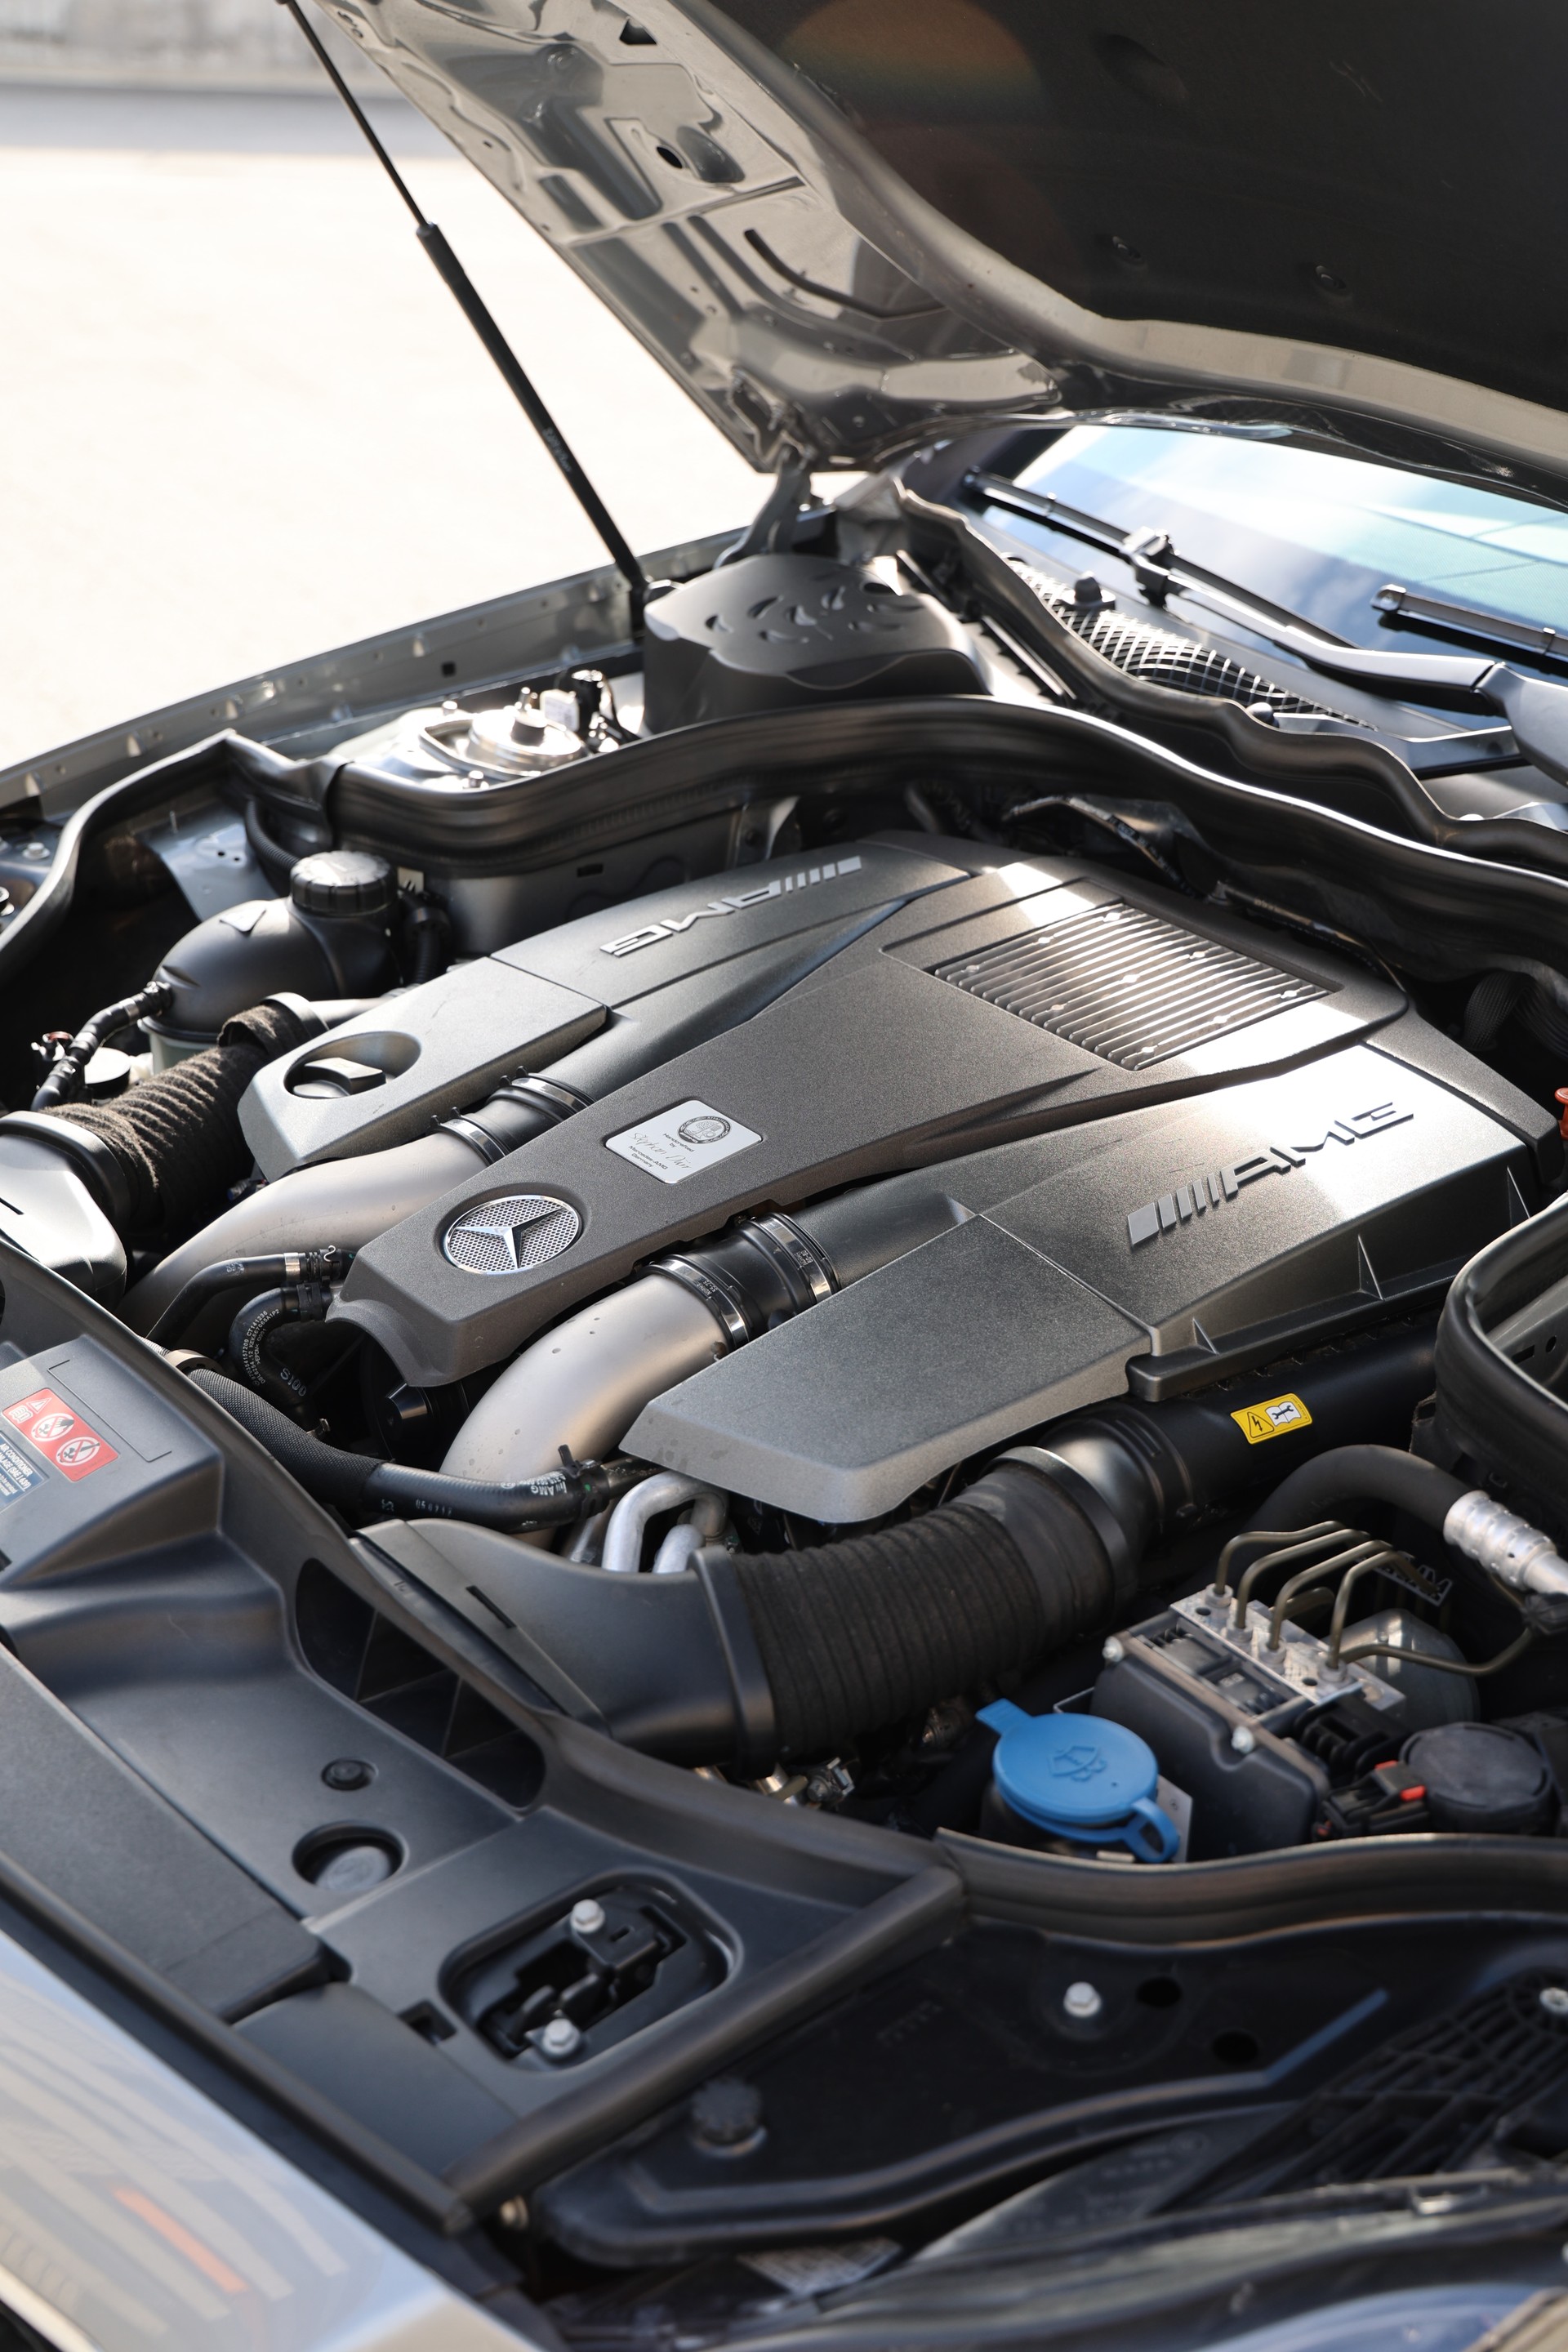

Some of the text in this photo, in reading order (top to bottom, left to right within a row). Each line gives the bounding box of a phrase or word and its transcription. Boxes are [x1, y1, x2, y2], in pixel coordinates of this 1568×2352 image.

[599, 879, 782, 958] AMG
[663, 1133, 696, 1153] Handcrafted
[1220, 1101, 1414, 1200] AMG
[628, 1145, 668, 1170] Mercedes-AMG
[631, 1153, 654, 1168] Germany
[531, 1485, 555, 1495] AMG
